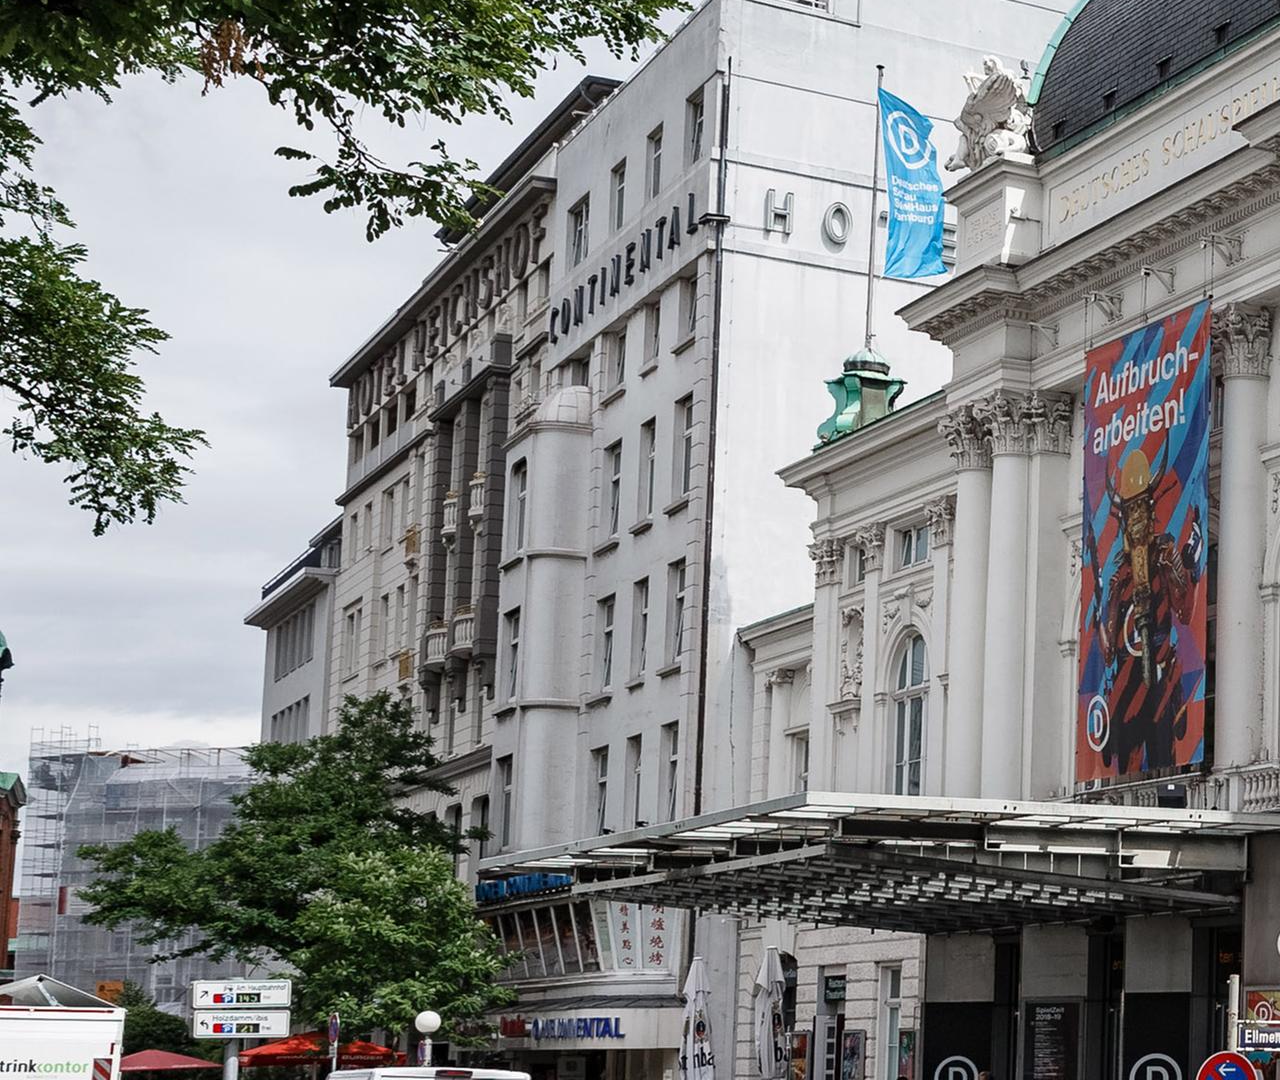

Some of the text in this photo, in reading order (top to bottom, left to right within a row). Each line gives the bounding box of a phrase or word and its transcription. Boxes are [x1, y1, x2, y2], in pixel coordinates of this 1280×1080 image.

[1059, 149, 1151, 224] DEUTSCHES
[550, 192, 699, 345] CONTINENTAL
[1095, 341, 1199, 408] Aufbruch-
[1093, 387, 1186, 454] arbeiten!
